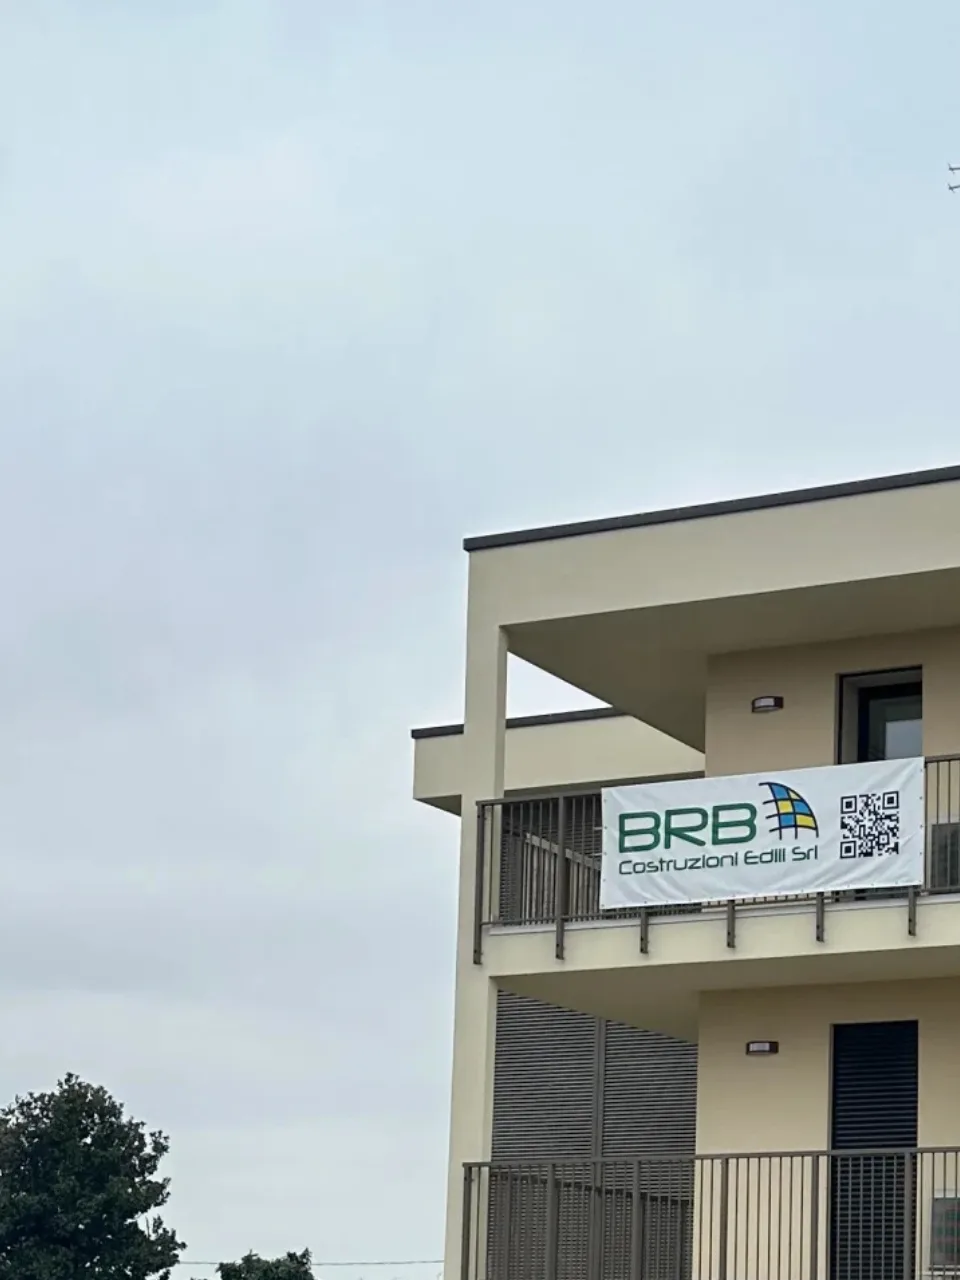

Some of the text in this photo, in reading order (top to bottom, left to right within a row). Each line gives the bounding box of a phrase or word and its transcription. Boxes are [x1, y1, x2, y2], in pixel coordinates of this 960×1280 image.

[618, 803, 757, 853] BRB
[619, 845, 818, 875] Costruzioni Edili Srl
